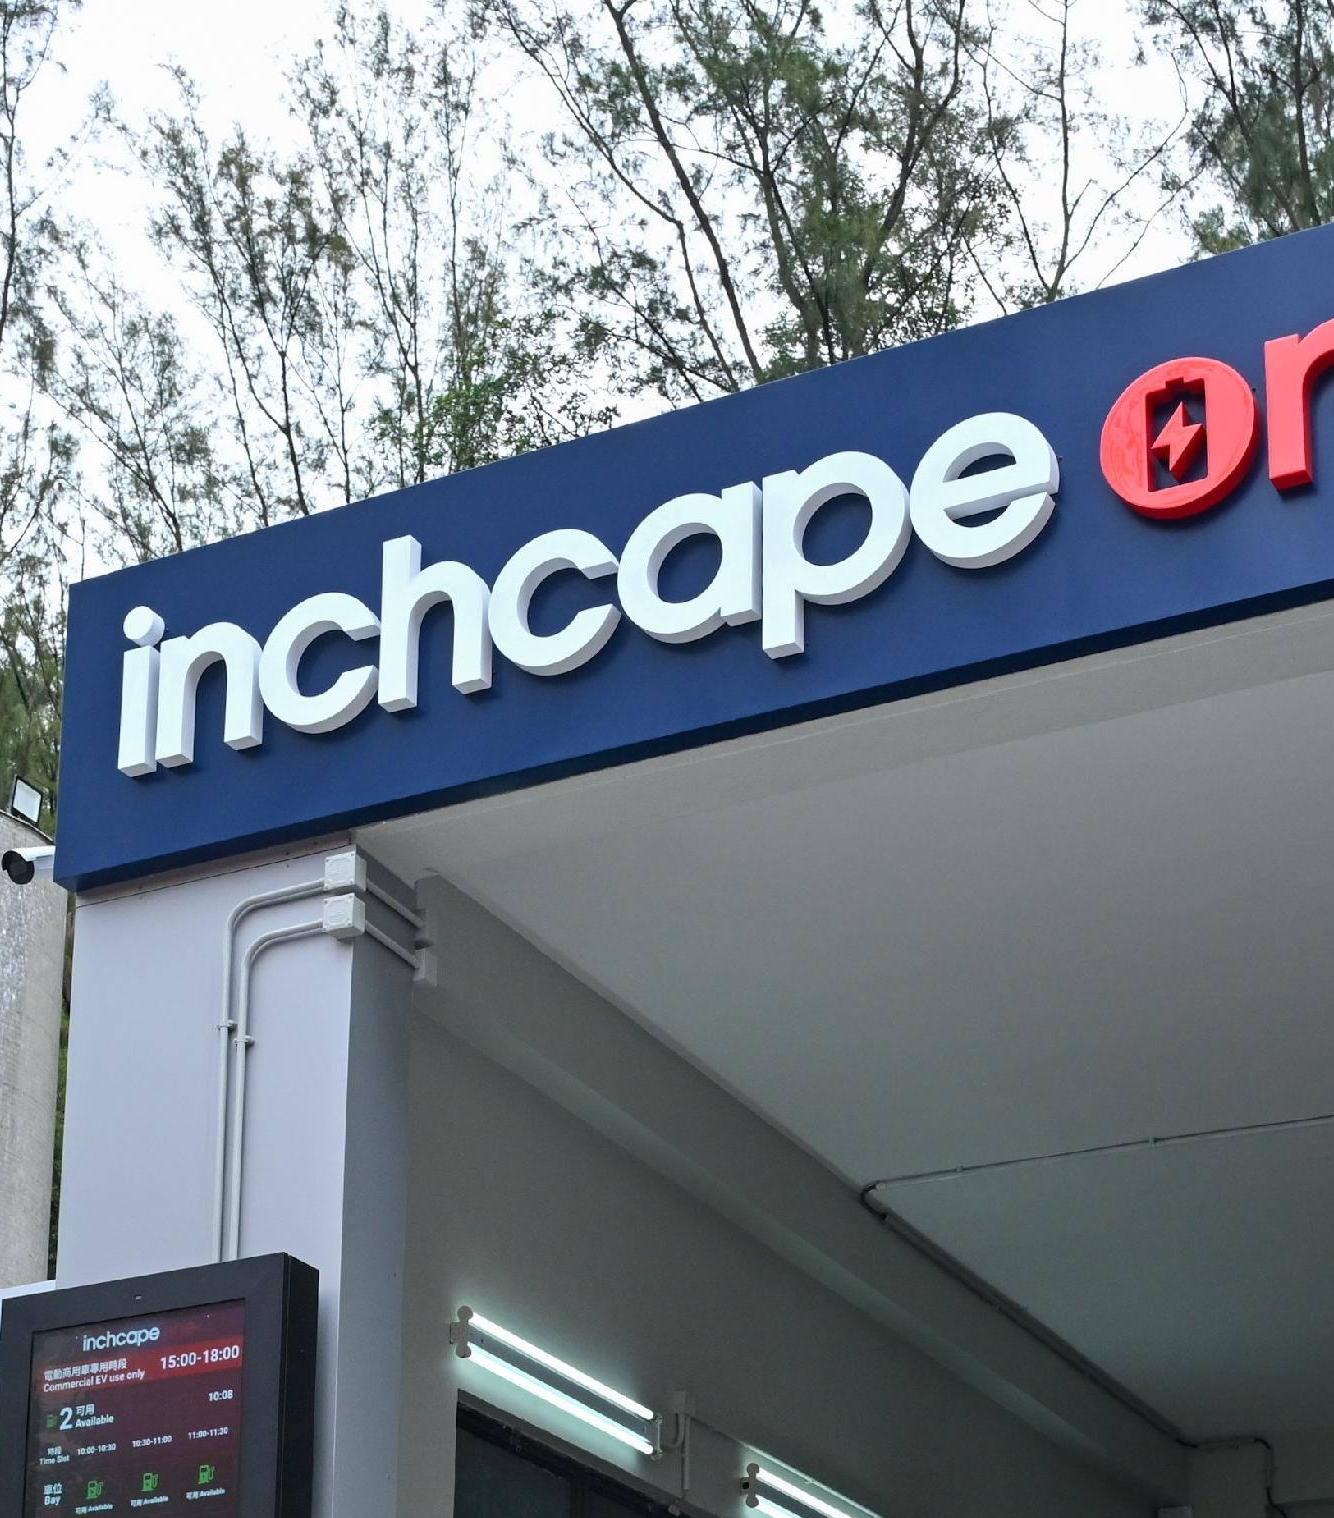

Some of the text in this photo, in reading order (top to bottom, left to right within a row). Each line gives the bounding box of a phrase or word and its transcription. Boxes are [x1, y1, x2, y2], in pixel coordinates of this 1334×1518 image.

[117, 411, 1058, 778] inchcape
[83, 1326, 160, 1351] inchcape
[160, 1345, 240, 1370] 15:00-18:00
[43, 1358, 127, 1381] 電動商用車專用時段
[43, 1369, 145, 1392] Commercial EV use only
[59, 1407, 73, 1431] 2
[75, 1415, 114, 1428] Available
[76, 1404, 95, 1416] 可用
[39, 1457, 55, 1465] Time
[44, 1494, 61, 1506] Bay
